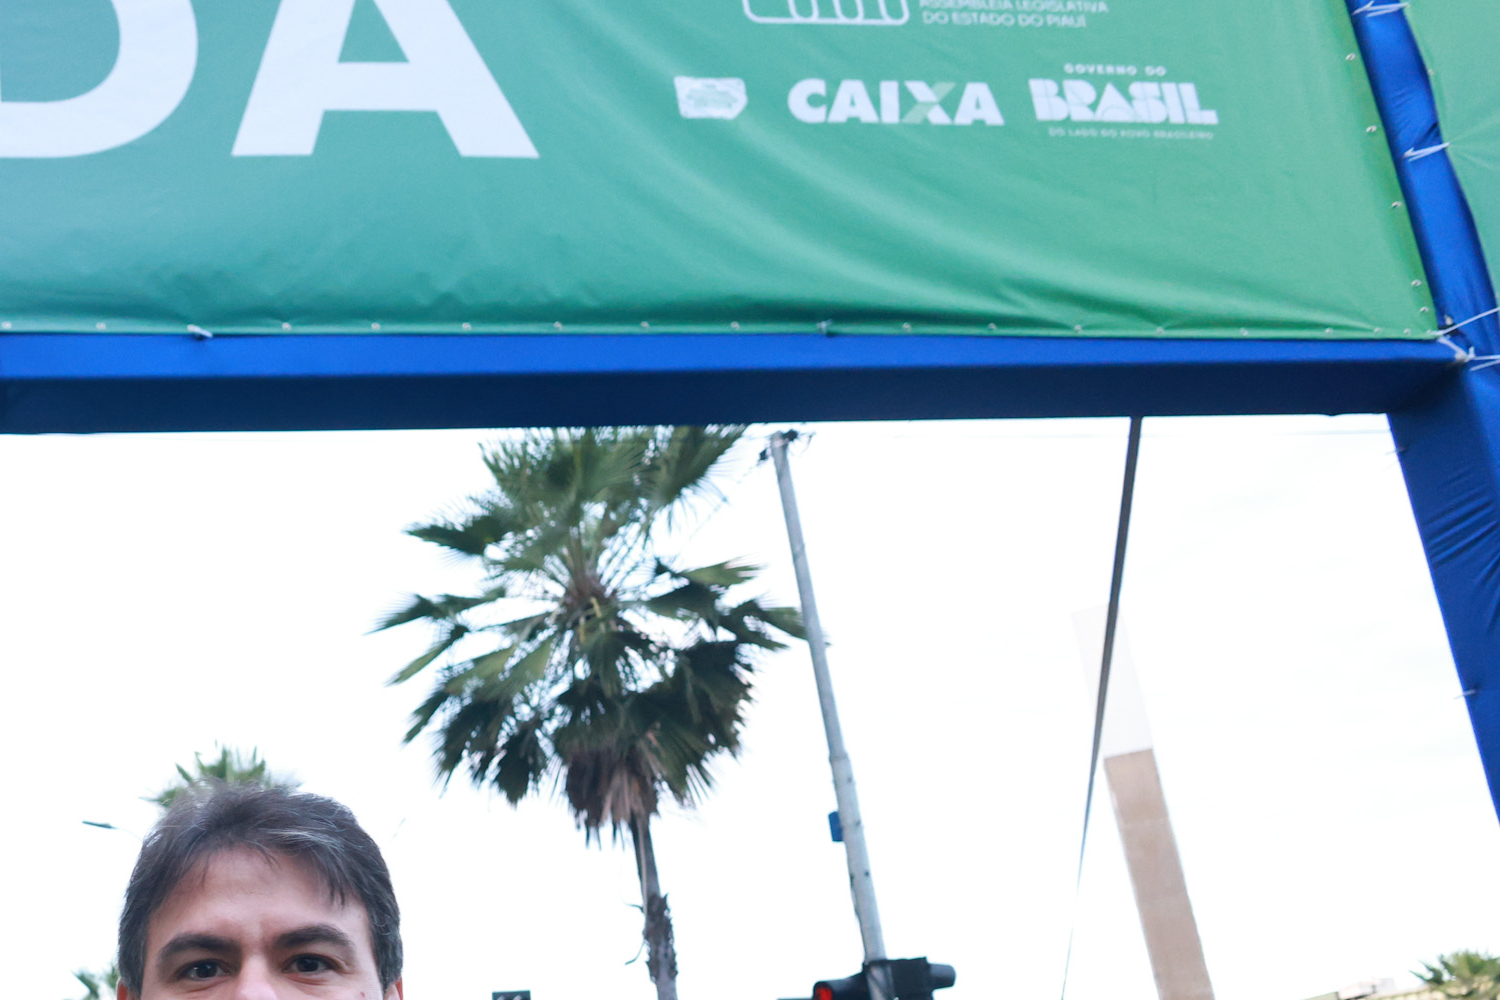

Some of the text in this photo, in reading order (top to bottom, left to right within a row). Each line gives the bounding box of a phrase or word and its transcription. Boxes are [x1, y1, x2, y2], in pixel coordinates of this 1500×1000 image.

[922, 10, 949, 25] DO
[951, 11, 1015, 27] ESTADO
[1017, 13, 1044, 27] DO
[1063, 62, 1167, 77] GOVERNO DO
[788, 78, 1004, 125] CAIXA
[1028, 78, 1219, 125] BRASIL
